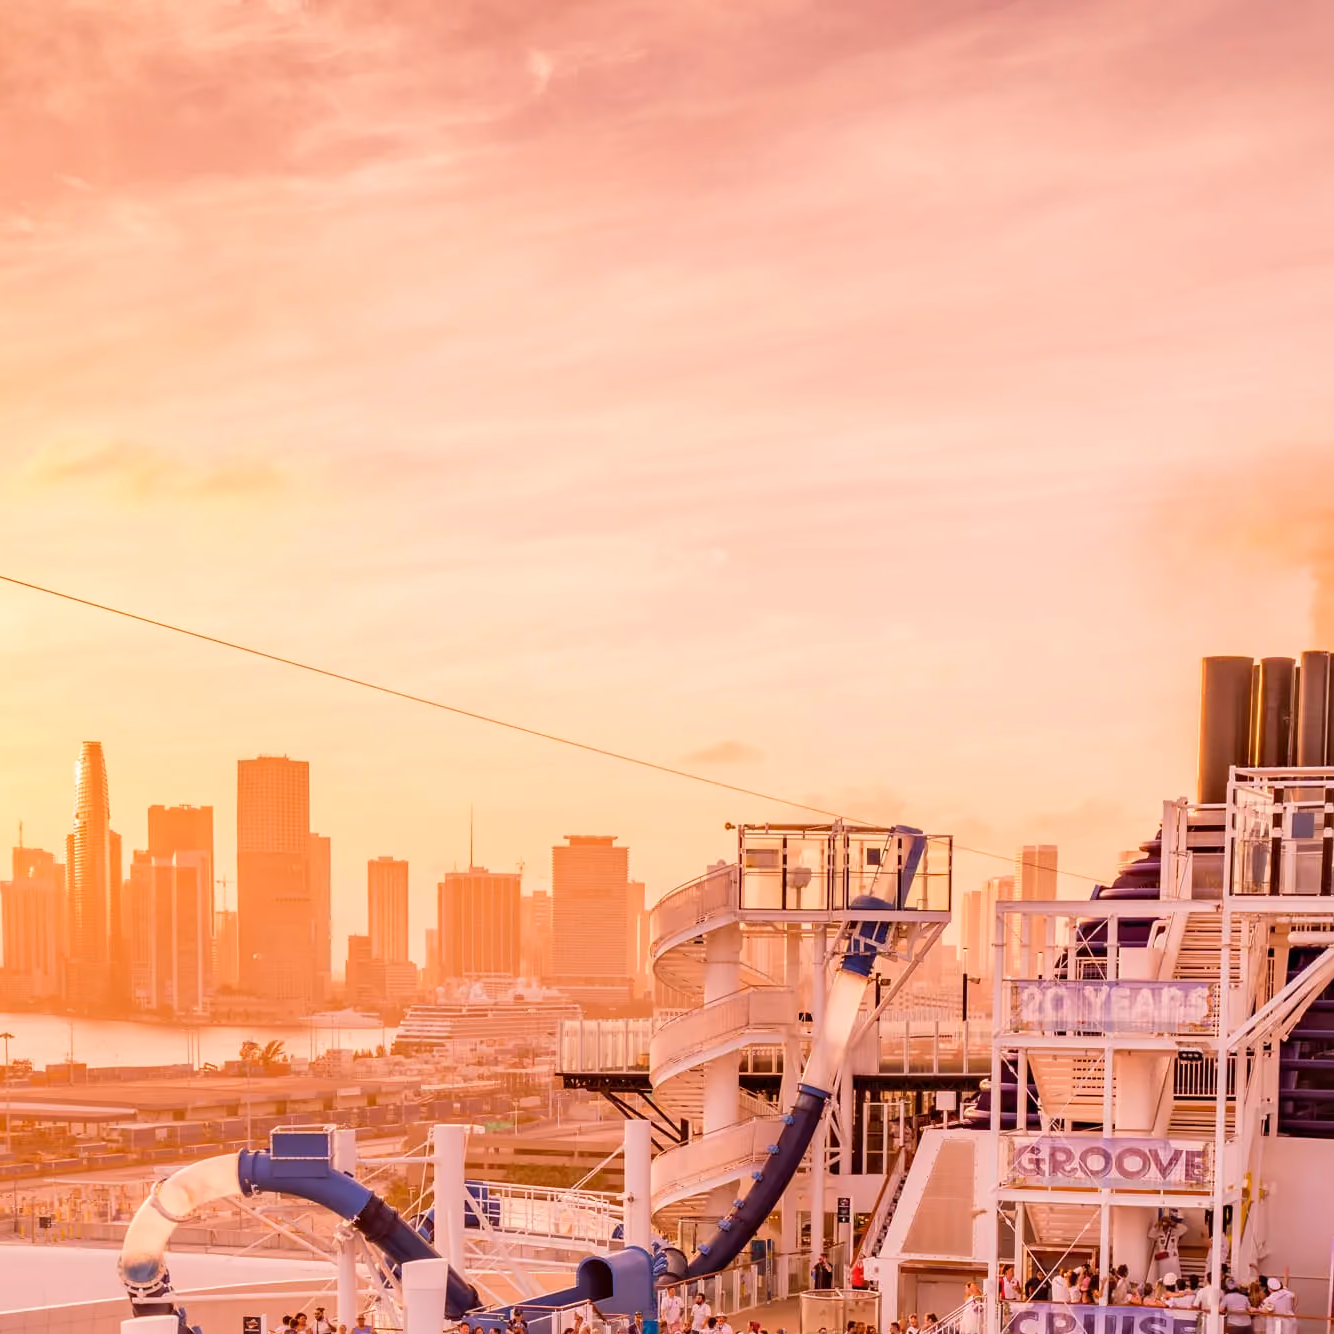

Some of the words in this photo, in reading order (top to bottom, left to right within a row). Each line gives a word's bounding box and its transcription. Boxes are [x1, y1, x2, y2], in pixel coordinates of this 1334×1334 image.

[1021, 985, 1069, 1022] 20
[1083, 985, 1210, 1023] YEARS
[1014, 1145, 1208, 1180] GROOVE
